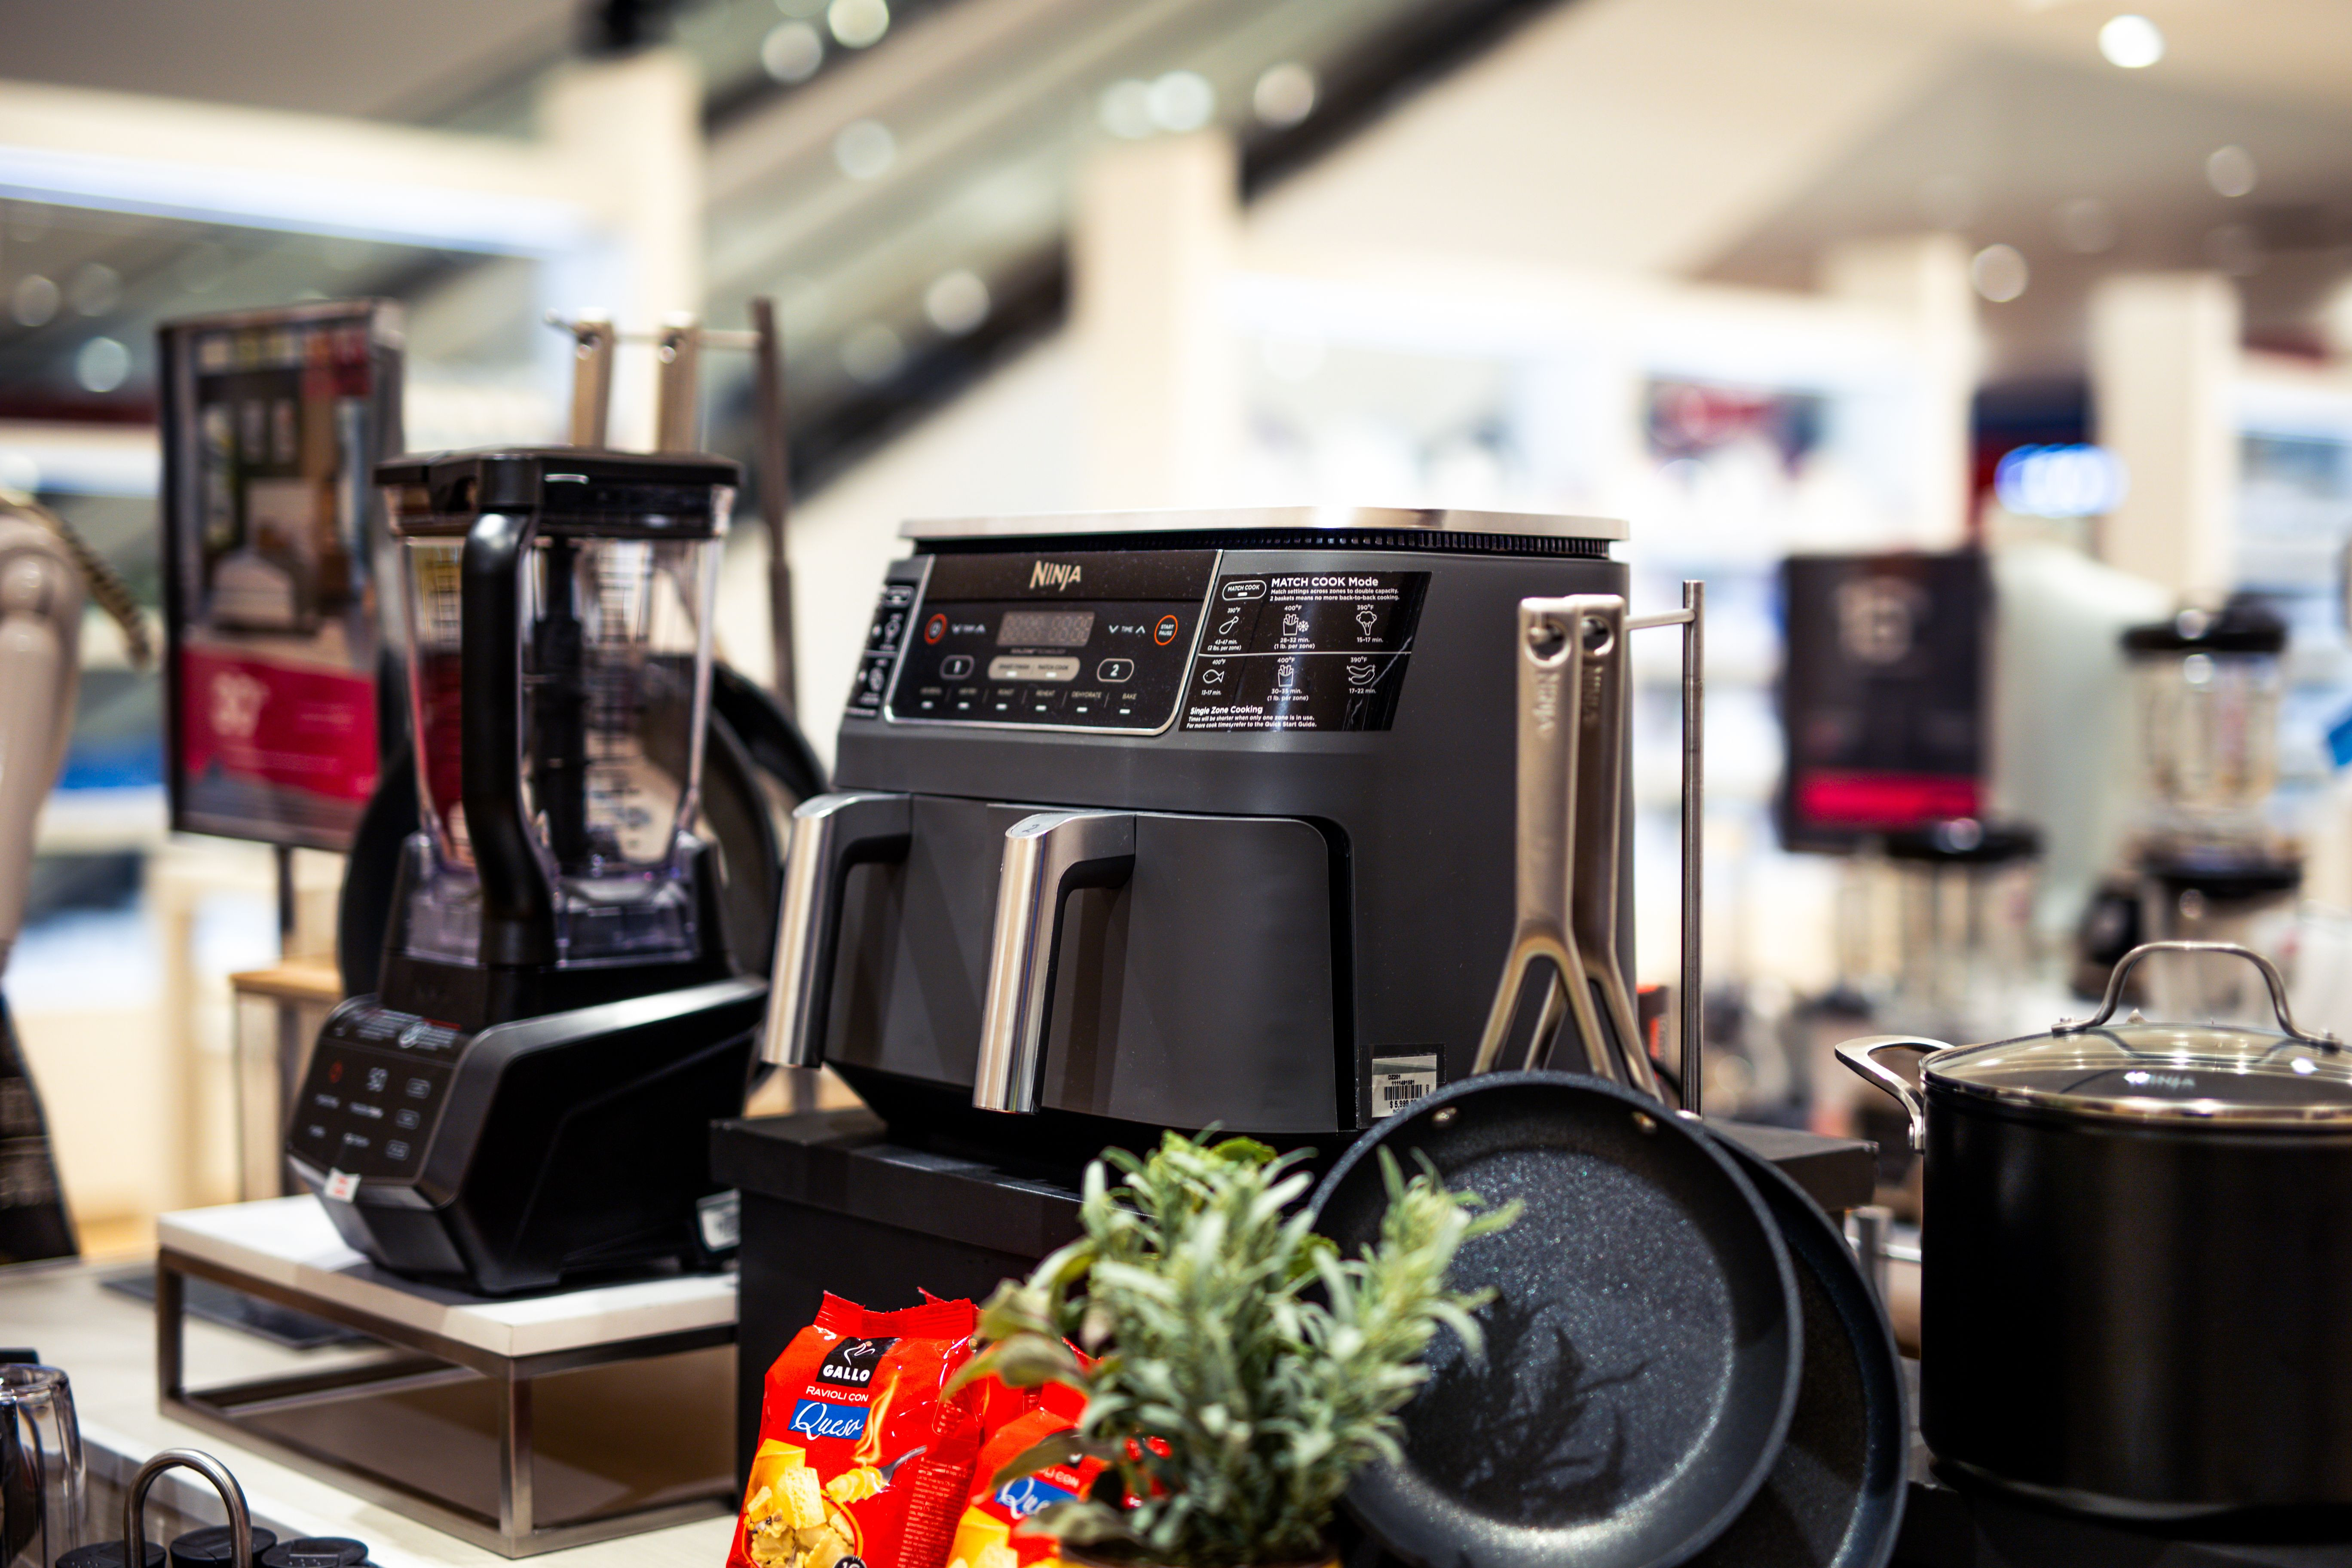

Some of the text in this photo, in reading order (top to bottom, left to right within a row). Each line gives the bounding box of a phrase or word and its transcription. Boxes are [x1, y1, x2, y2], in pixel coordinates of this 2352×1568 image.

[1029, 560, 1081, 591] NINJA
[1271, 576, 1378, 587] MATCH COOK Mode
[1110, 664, 1120, 677] 2
[1190, 706, 1210, 716] Single
[1230, 705, 1263, 714] Cooking
[1390, 1100, 1393, 1109] $
[823, 1365, 870, 1381] GALLO
[806, 1385, 869, 1402] RAVIOLI CON
[791, 1402, 864, 1440] Queso
[1055, 1470, 1079, 1488] CON
